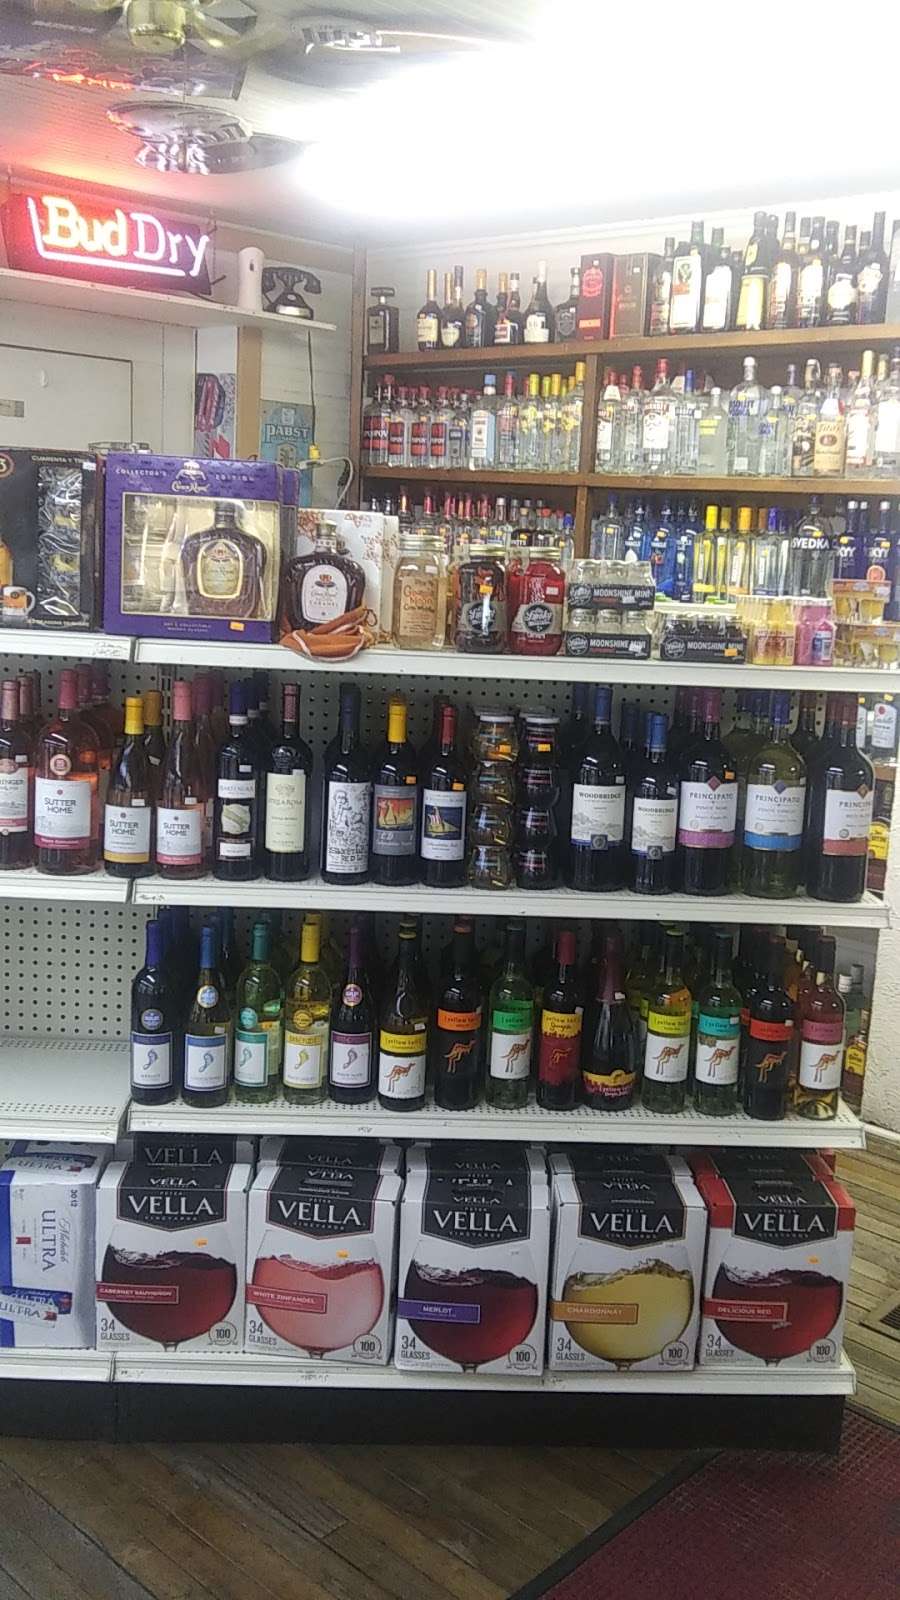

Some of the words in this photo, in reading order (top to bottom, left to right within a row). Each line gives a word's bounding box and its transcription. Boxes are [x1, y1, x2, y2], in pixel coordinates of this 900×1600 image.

[42, 195, 128, 256] Bud
[130, 212, 210, 277] Dry
[264, 423, 310, 443] PABST
[593, 588, 633, 597] MOONSHINE
[589, 639, 629, 648] MOONSHINE
[687, 640, 726, 650] MOONSHINE
[44, 797, 76, 806] SUTTER
[689, 792, 734, 800] PRINCIPATO
[755, 794, 801, 803] PRINCIPATO
[48, 806, 73, 814] HOME
[110, 820, 139, 829] SUTTER
[144, 1148, 223, 1164] VELLA
[150, 1178, 198, 1186] VELLA
[128, 1195, 214, 1215] VELLA
[277, 1200, 361, 1225] VELLA
[433, 1210, 518, 1232] VELLA
[590, 1212, 674, 1232] VELLA
[743, 1213, 825, 1232] VELLA
[42, 1210, 56, 1272] ULTRA
[253, 1290, 275, 1299] WHITE
[276, 1294, 316, 1304] ZINFANDEL
[422, 1306, 453, 1314] MERLOT
[101, 1318, 115, 1332] 34
[249, 1320, 263, 1335] 34
[100, 1333, 130, 1341] GLASSES
[215, 1328, 230, 1339] 100
[248, 1334, 277, 1346] GLASSES
[401, 1335, 416, 1350] 34
[557, 1337, 571, 1352] 34
[706, 1334, 722, 1349] 34
[360, 1341, 376, 1352] 100
[816, 1345, 831, 1356] 100
[400, 1350, 431, 1361] GLASSES
[516, 1351, 531, 1362] 100
[555, 1352, 586, 1361] GLASSES
[668, 1347, 682, 1358] 100
[705, 1349, 735, 1357] GLASSES
